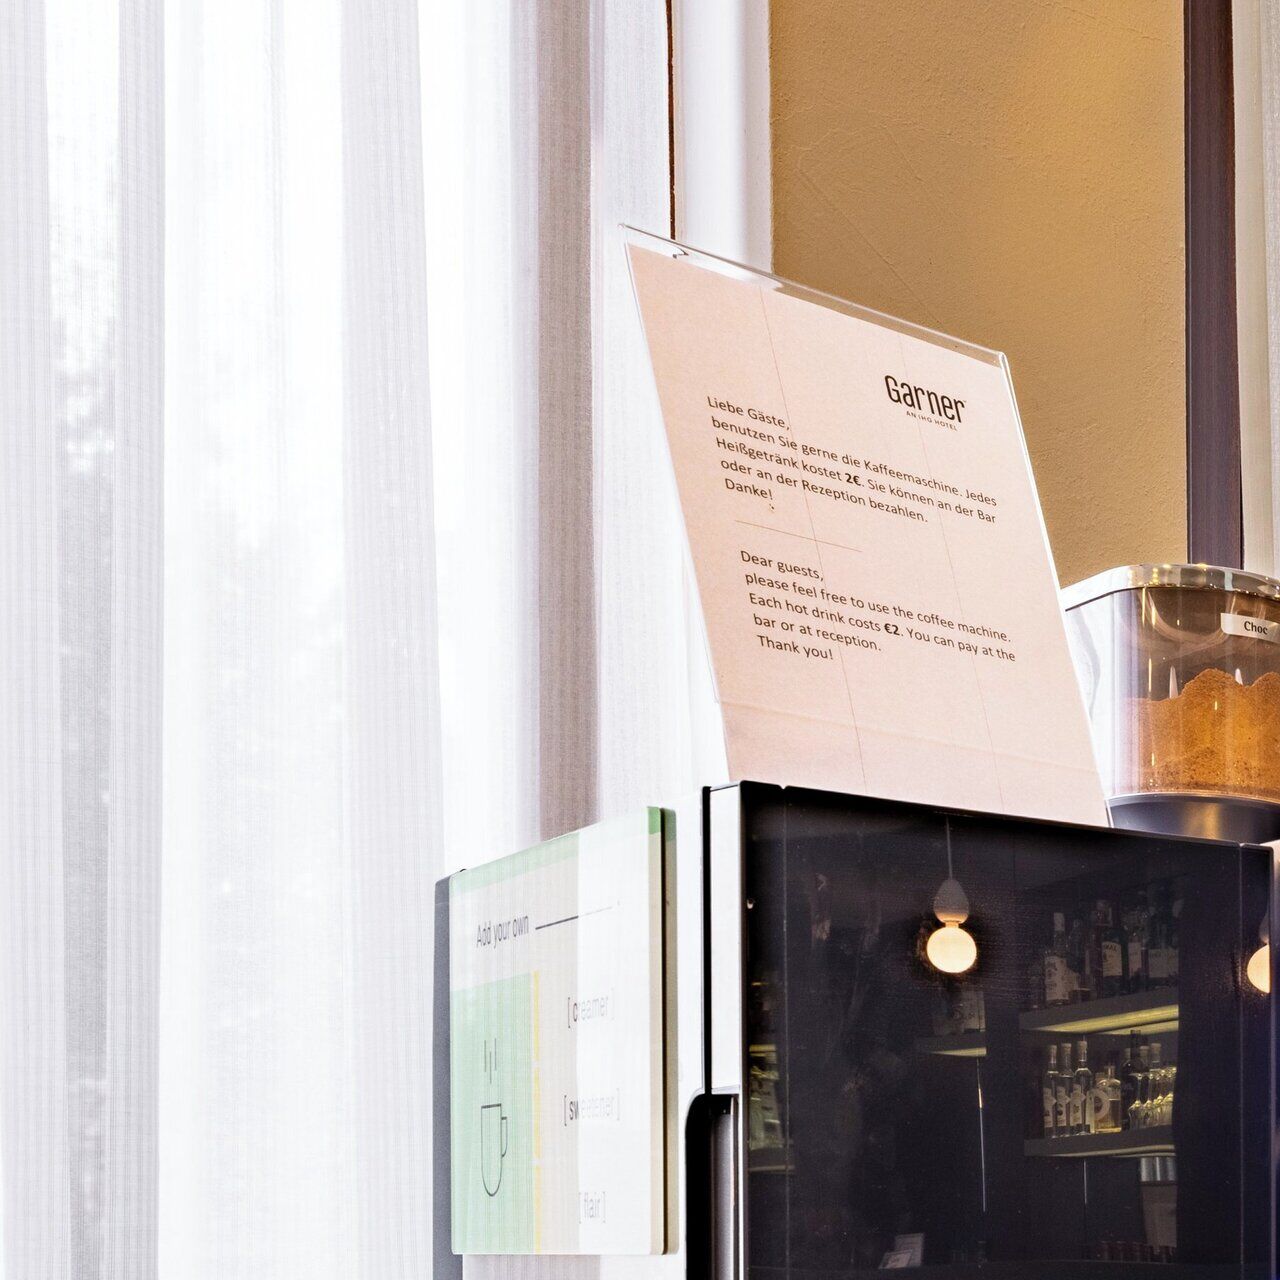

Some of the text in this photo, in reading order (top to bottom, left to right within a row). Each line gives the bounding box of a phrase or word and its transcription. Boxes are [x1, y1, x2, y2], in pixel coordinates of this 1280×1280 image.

[707, 395, 790, 431] Liebe Gäste,
[884, 375, 965, 423] Garner
[906, 410, 958, 432] AN IHG HOTEL
[711, 415, 998, 508] benutzen Sie gerne die Kaffeemaschine. Jedes
[715, 436, 997, 525] Heißgetränk kostet 2€. Sie können an der Bar
[720, 459, 928, 523] oder an der Rezeption bezahlen.
[724, 478, 774, 501] Danke!
[740, 550, 825, 582] Dear guests,
[745, 573, 1011, 642] please feel free to use the coffee machine.
[748, 592, 1016, 662] Each hot drink costs €2. You can pay at the
[754, 613, 882, 652] bar or at reception.
[1243, 620, 1268, 635] Choc
[757, 635, 834, 661] Thank you!
[476, 914, 529, 950] Add your own
